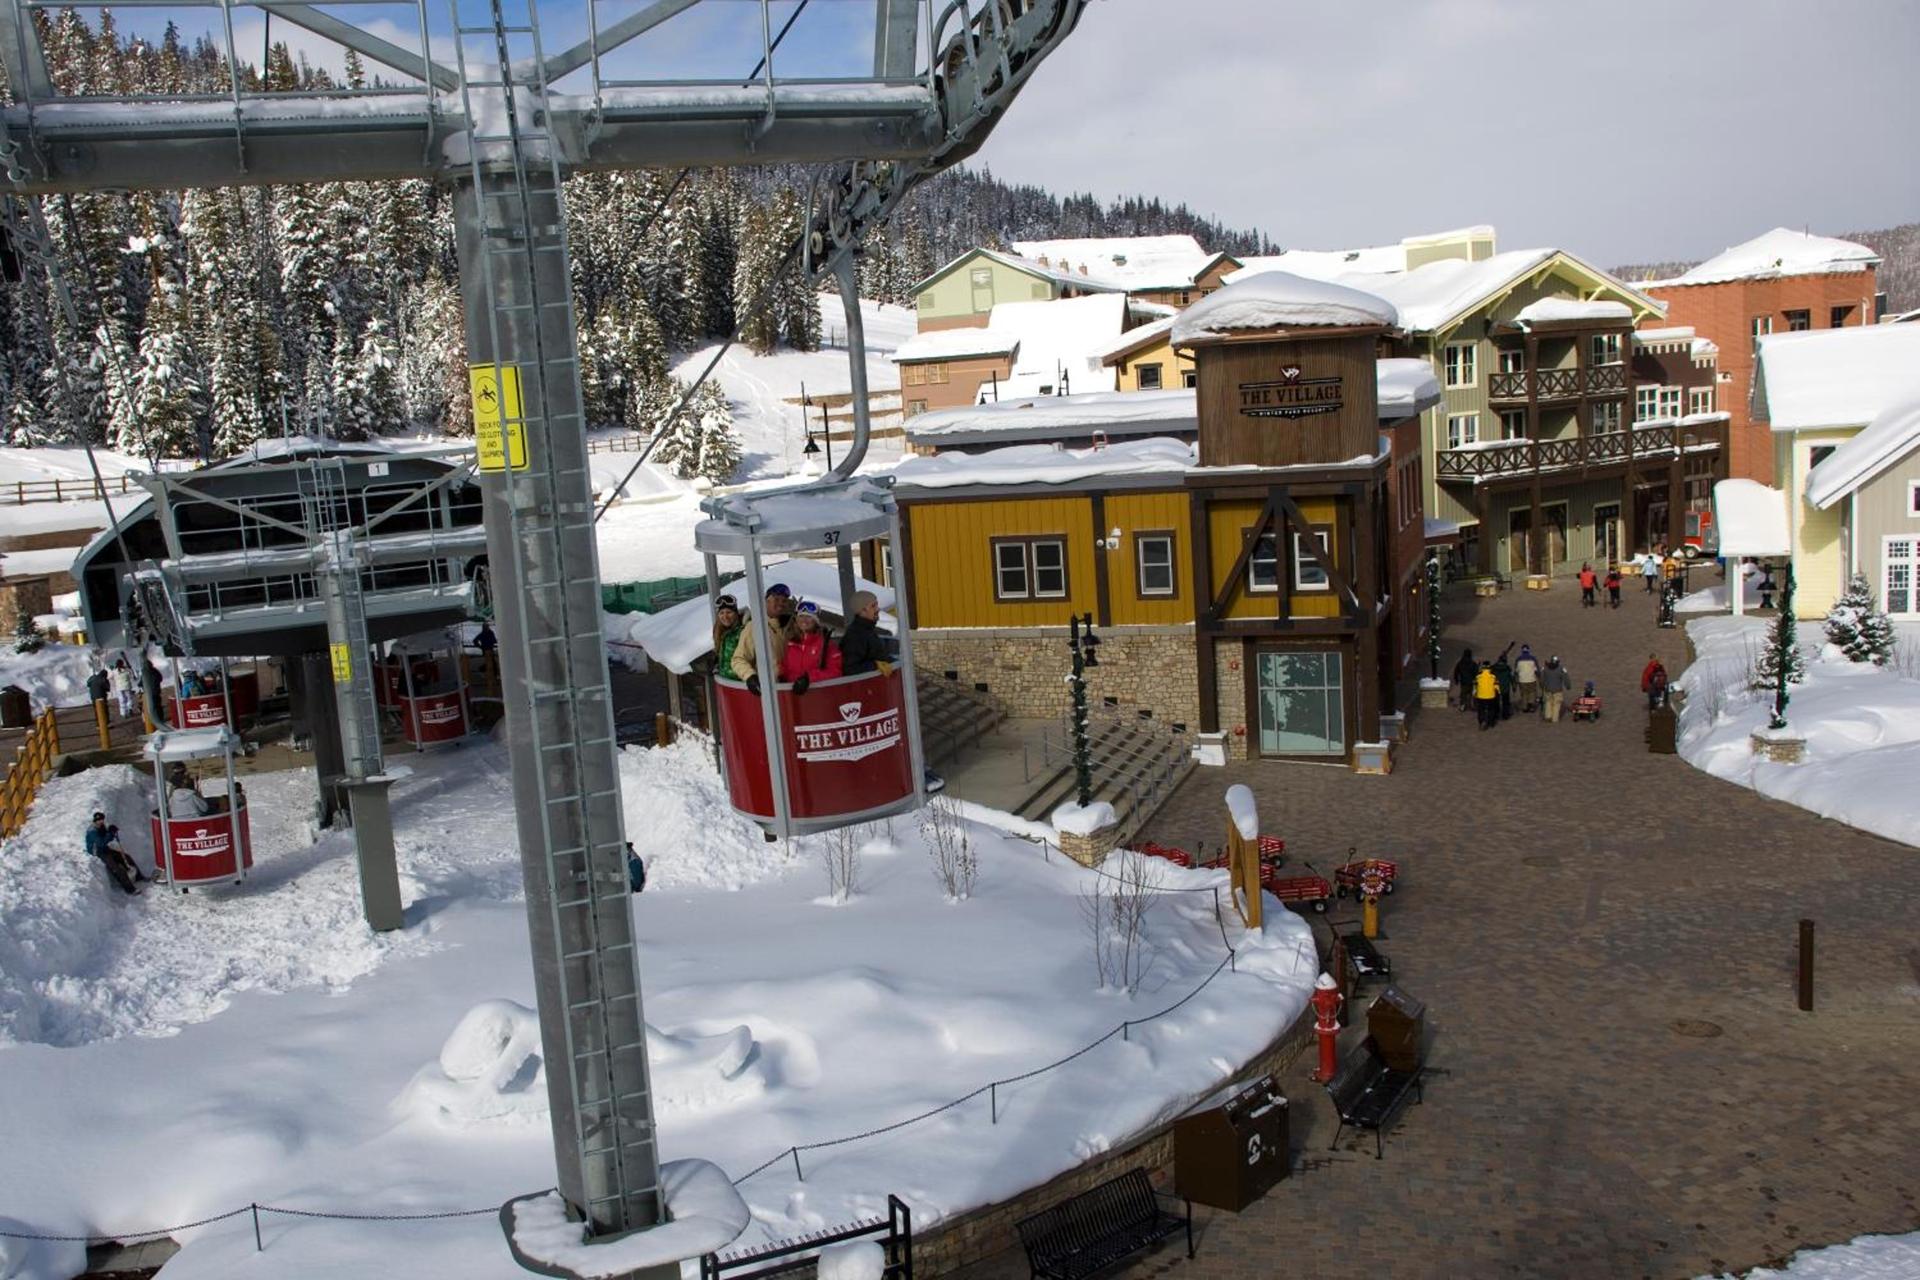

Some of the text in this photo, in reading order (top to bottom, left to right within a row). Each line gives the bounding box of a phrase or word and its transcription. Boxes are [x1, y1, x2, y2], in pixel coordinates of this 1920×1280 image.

[1241, 385, 1342, 405] THE VILLAGE
[824, 530, 840, 545] 37
[797, 718, 899, 749] THE VILLAGE
[176, 837, 229, 850] THE VILLAGE
